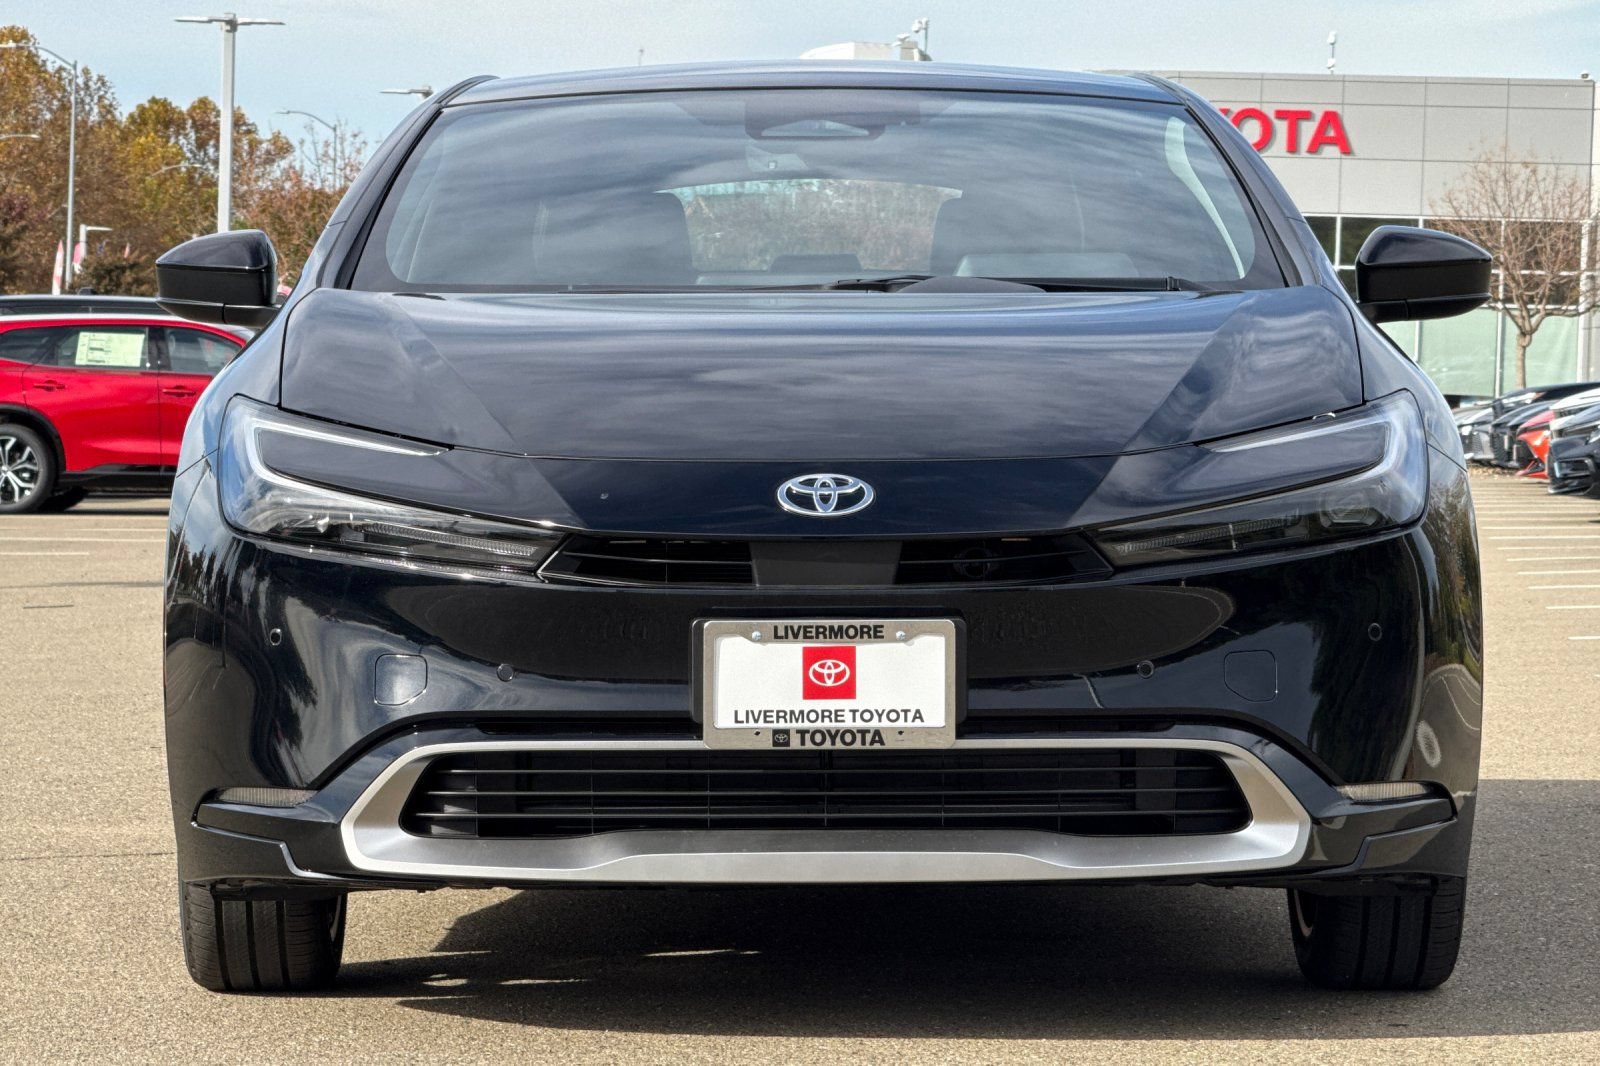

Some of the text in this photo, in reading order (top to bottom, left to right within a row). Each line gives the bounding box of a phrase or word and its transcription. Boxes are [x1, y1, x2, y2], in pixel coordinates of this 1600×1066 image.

[1218, 107, 1352, 155] OTA
[773, 624, 885, 640] LIVERMORE
[734, 708, 925, 724] LIVERMORE TOYOTA
[796, 729, 885, 747] TOYOTA
